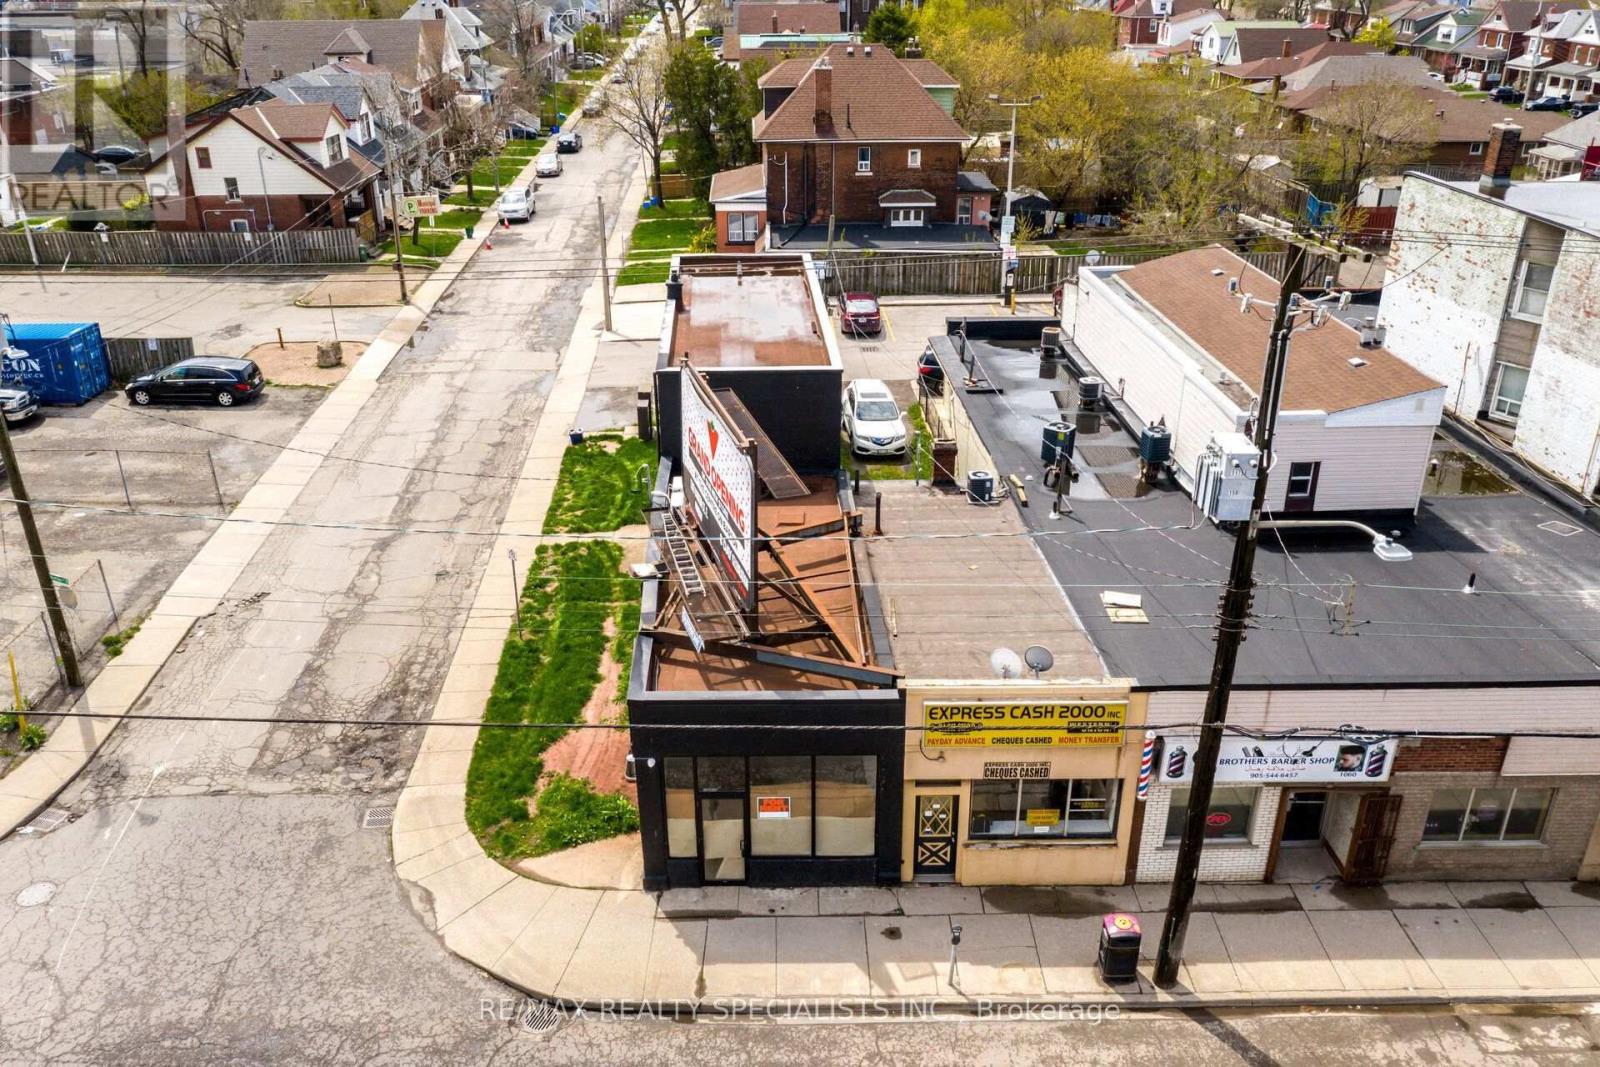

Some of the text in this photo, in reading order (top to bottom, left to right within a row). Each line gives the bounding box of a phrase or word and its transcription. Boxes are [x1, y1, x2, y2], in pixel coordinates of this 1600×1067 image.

[689, 427, 711, 477] GRAND
[711, 465, 746, 533] OPENING
[929, 706, 1006, 720] EXPRESS
[1010, 705, 1055, 719] CASH
[1058, 705, 1106, 719] 2000
[955, 737, 986, 745] ADVANCE
[991, 737, 1024, 745] CHEQUES
[1025, 736, 1053, 744] CASHED
[1059, 736, 1082, 744] MONEY
[1085, 736, 1120, 744] TRANSFER
[1219, 757, 1336, 766] BROTHERS BARBER SHOP
[984, 767, 1049, 778] CHEQUES CASHED
[762, 797, 785, 806] FOR
